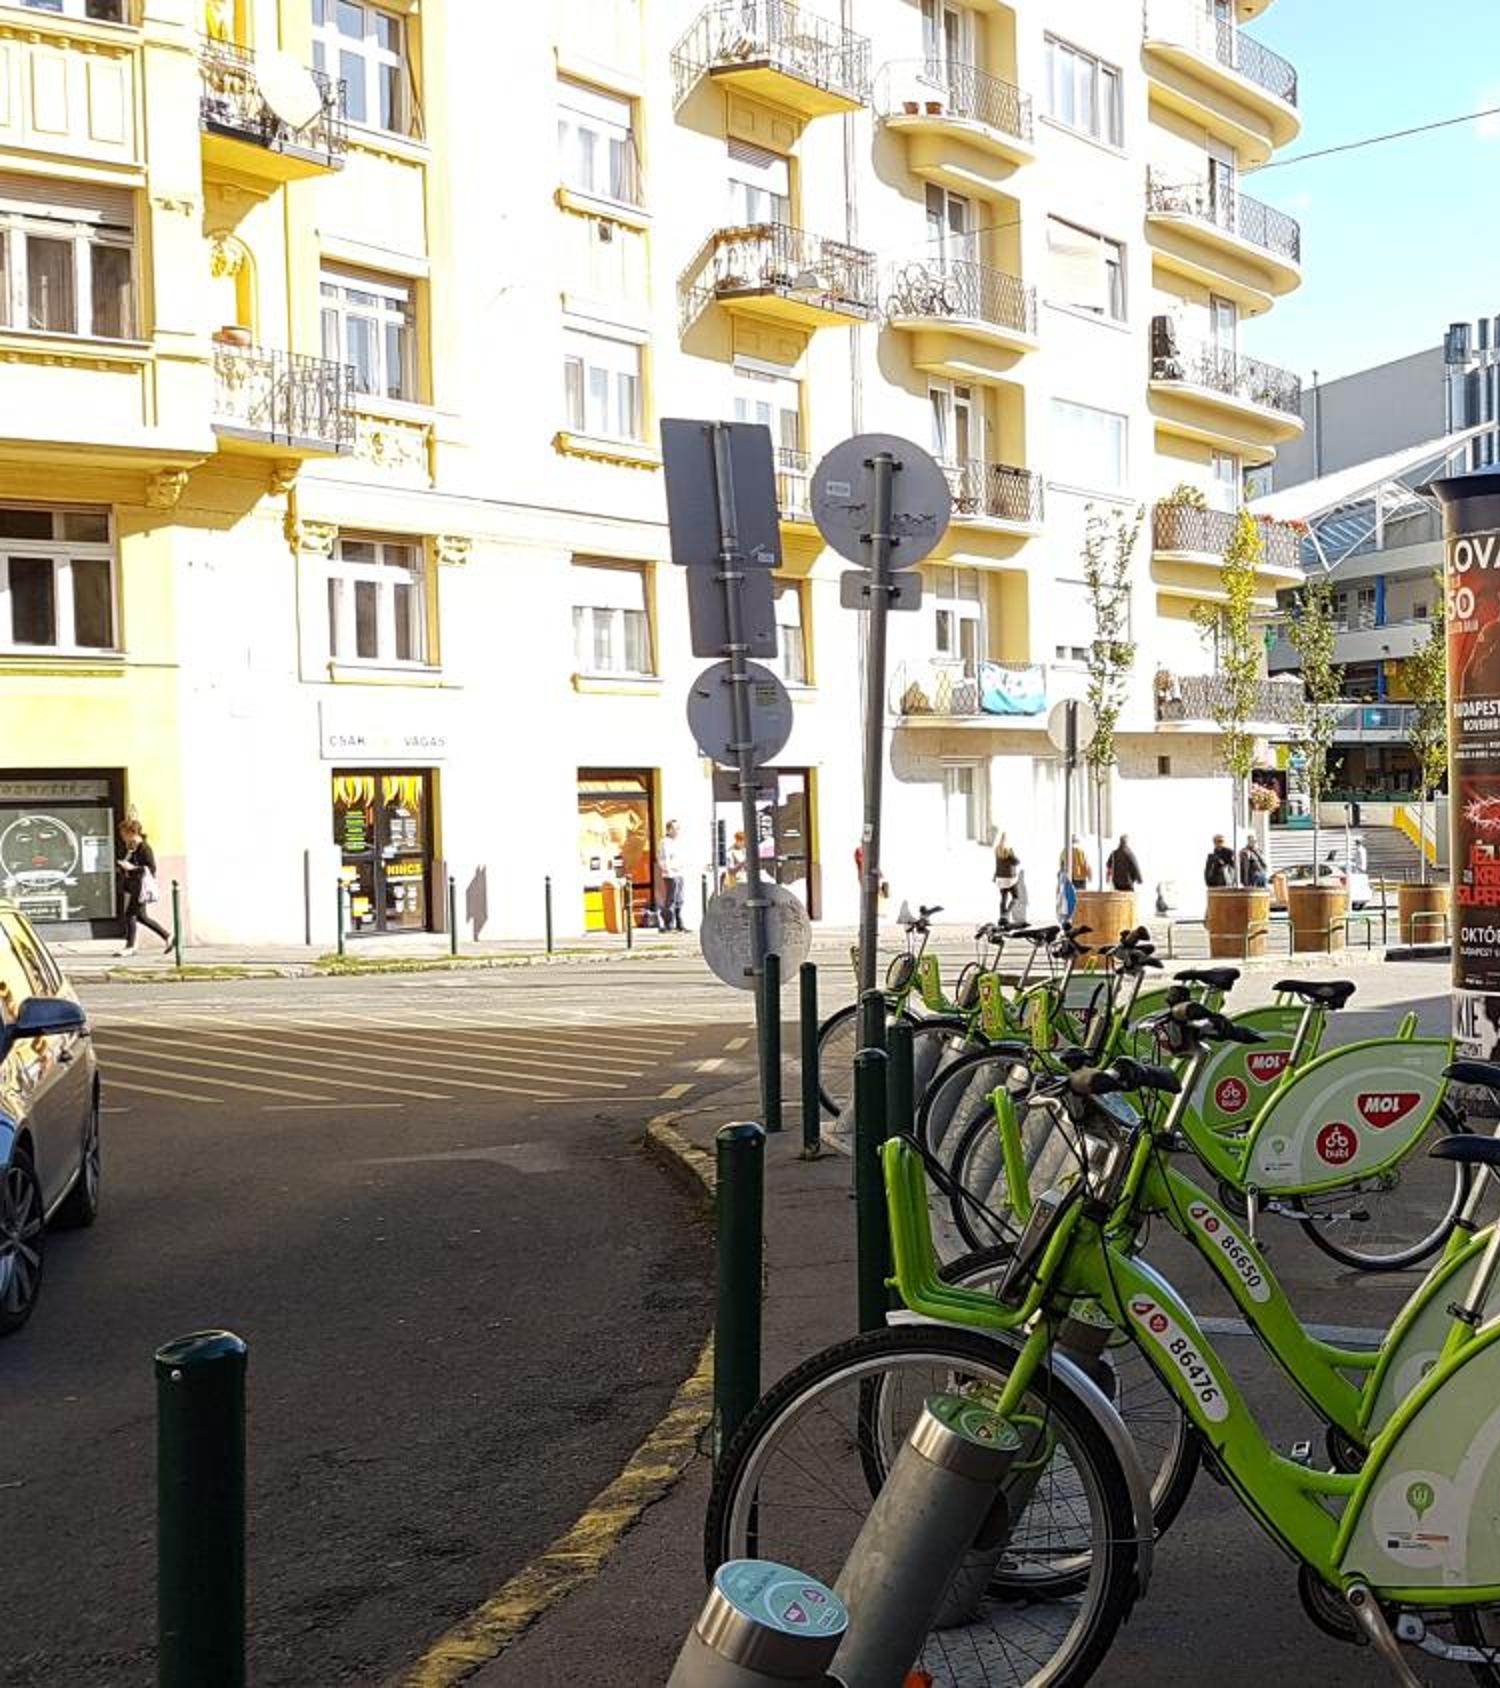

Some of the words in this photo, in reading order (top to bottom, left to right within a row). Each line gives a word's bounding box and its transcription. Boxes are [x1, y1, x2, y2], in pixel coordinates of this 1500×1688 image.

[1252, 1056, 1280, 1069] MOL
[1364, 1097, 1400, 1113] MOL
[1325, 1147, 1349, 1159] bubi
[1221, 1235, 1261, 1288] 86650
[1169, 1338, 1219, 1403] 86476
